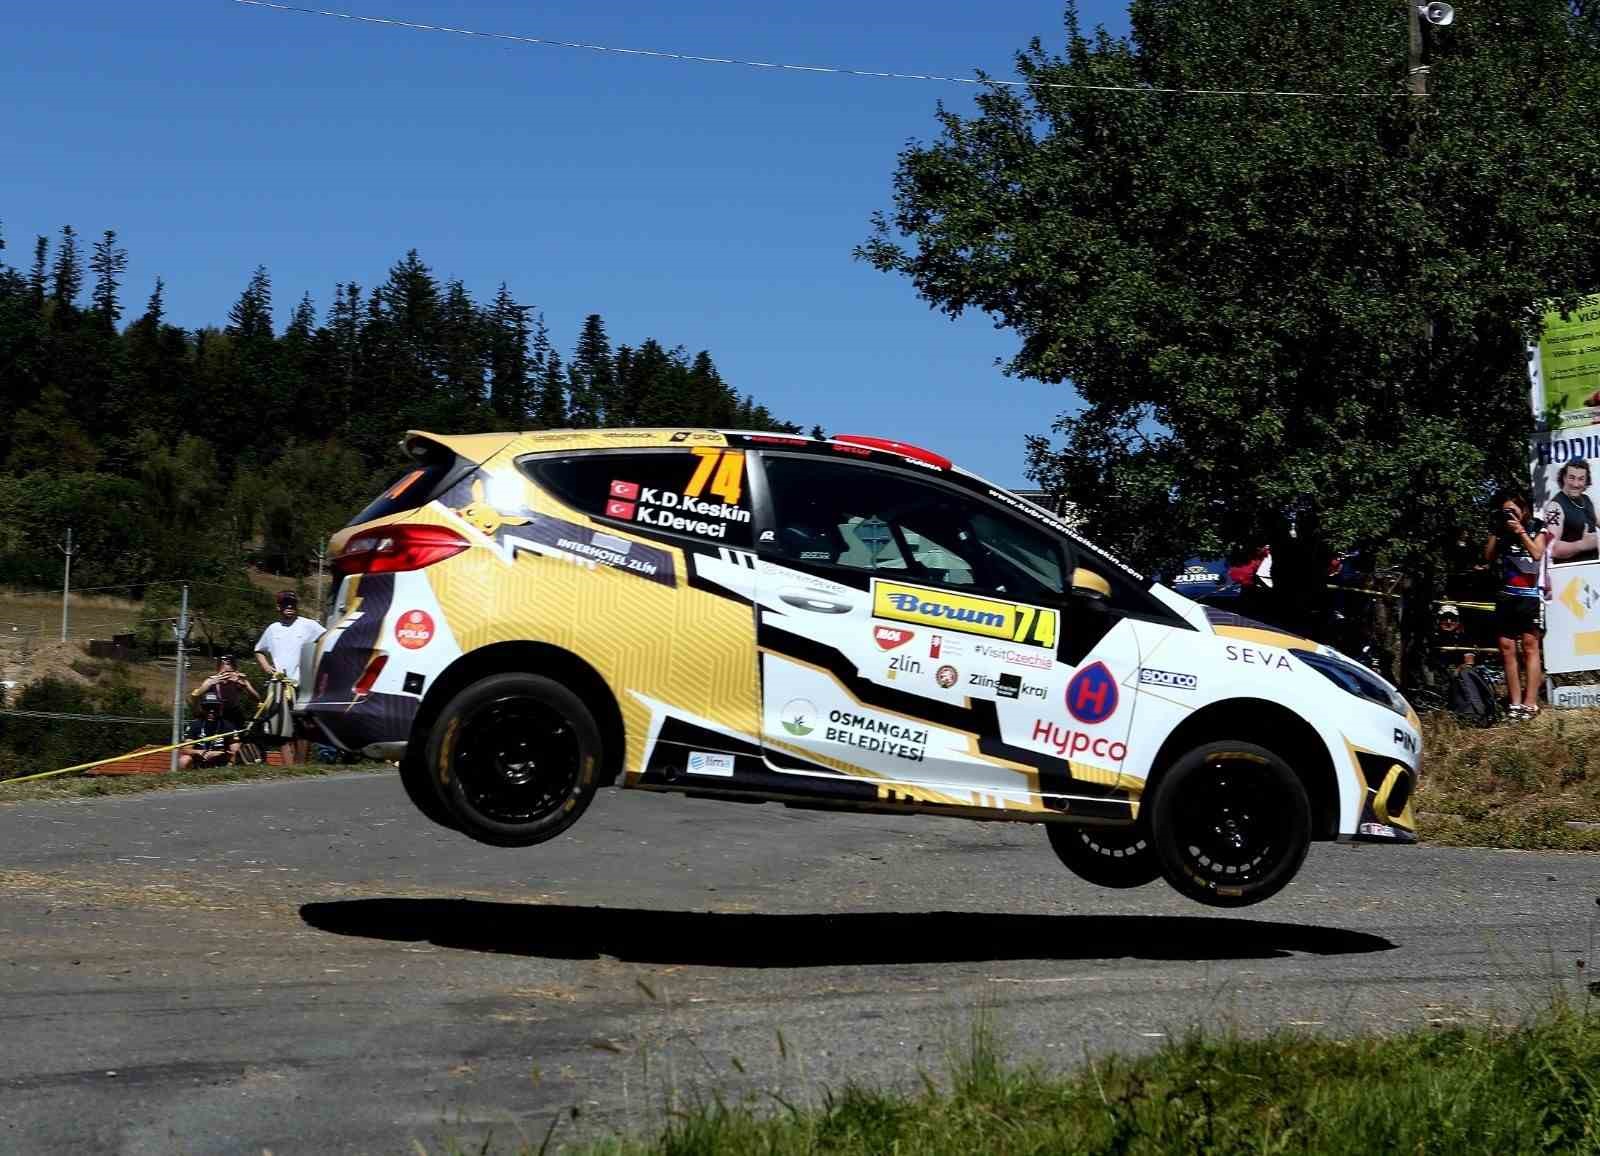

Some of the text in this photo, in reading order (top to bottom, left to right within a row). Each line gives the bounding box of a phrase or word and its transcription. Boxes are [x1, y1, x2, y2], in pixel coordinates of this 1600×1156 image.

[683, 446, 745, 505] 74
[636, 506, 726, 538] K.Deveci
[640, 487, 750, 523] K.D.Keskin
[556, 538, 658, 576] INTERHOTEL ZLÍN
[887, 592, 1056, 648] Barum 74
[1226, 645, 1294, 672] SEVA
[1021, 682, 1049, 700] kraj
[1141, 670, 1197, 687] sparco
[825, 727, 926, 762] BELEDİYESİ
[829, 709, 929, 745] OSMANGAZİ
[1032, 719, 1128, 762] Hypco
